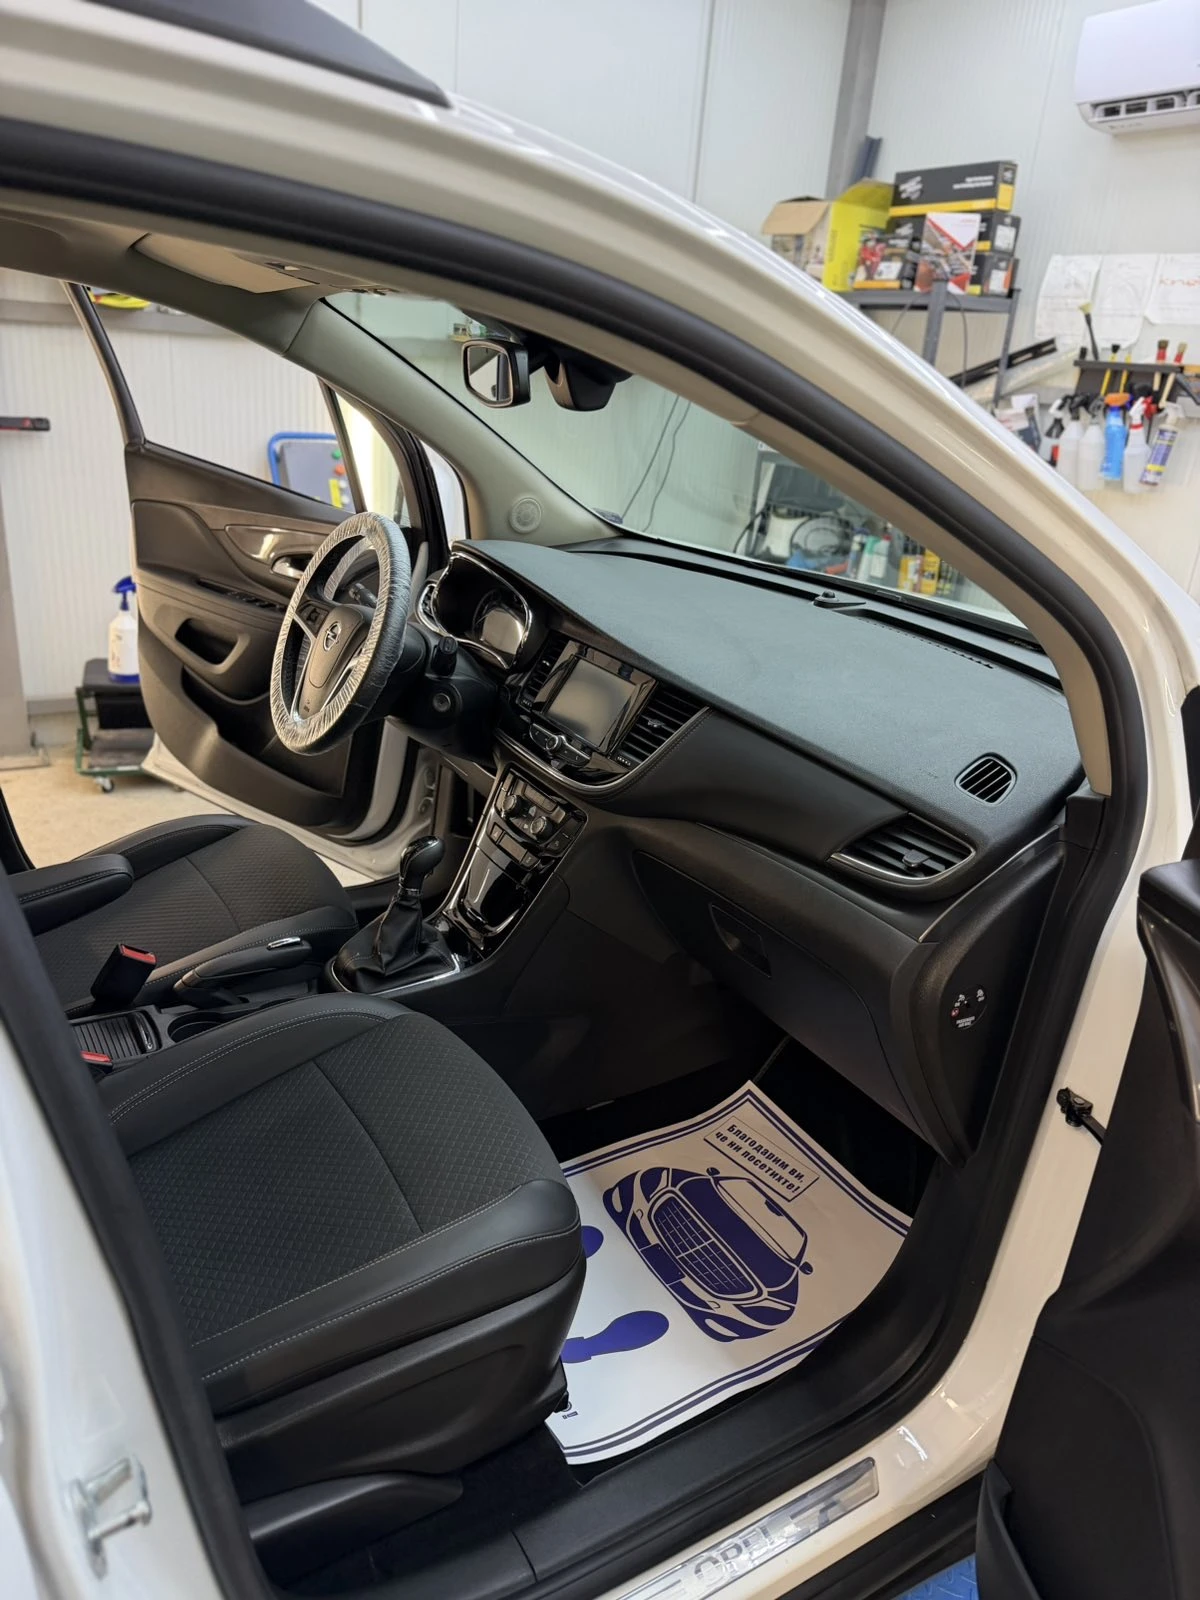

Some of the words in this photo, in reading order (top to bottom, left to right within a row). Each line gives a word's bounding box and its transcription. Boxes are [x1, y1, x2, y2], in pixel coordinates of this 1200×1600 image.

[715, 1131, 730, 1143] че
[727, 1141, 743, 1153] ни
[742, 1150, 801, 1193] посетихте!
[727, 1124, 789, 1171] Благодарим
[788, 1168, 805, 1183] ви,
